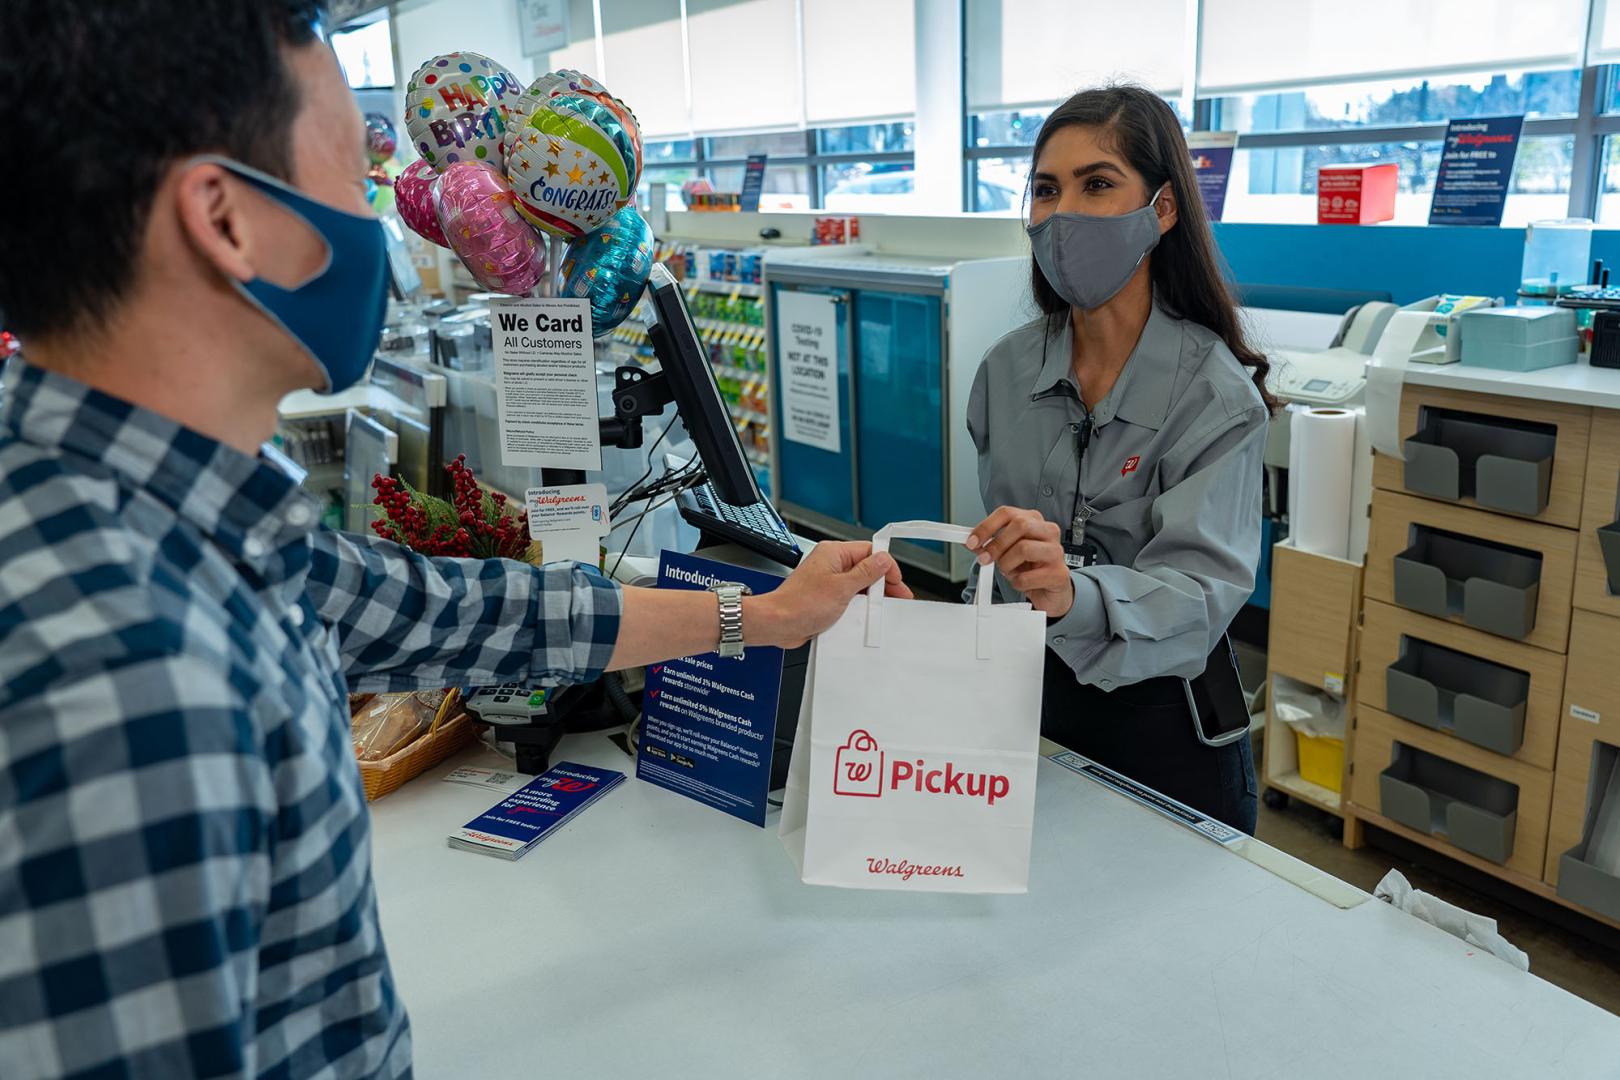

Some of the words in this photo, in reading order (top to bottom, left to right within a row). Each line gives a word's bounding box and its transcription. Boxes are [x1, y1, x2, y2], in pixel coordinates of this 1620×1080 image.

[439, 71, 521, 111] HAPPY
[530, 177, 618, 211] CONGRATS!
[498, 314, 528, 331] We
[536, 314, 583, 332] Card
[504, 337, 517, 347] All
[521, 337, 582, 348] Customers
[666, 564, 728, 587] Introducin
[696, 659, 713, 670] prices
[662, 676, 683, 687] rewards
[663, 666, 675, 675] Earn
[676, 671, 702, 684] unlimited
[711, 681, 740, 696] Walgreens
[740, 690, 754, 700] Cash
[659, 701, 680, 712] rewards
[688, 710, 715, 724] Walgreens
[715, 718, 738, 732] branded
[661, 691, 673, 700] Earn
[673, 696, 699, 709] unlimited
[699, 704, 708, 712] 5%
[709, 707, 737, 722] Walgreens
[738, 717, 751, 727] Cash
[552, 768, 600, 781] Introducing
[891, 759, 1010, 805] Pickup
[508, 799, 556, 811] experience
[515, 794, 560, 806] rewarding
[521, 821, 540, 831] today!
[867, 858, 964, 881] Walgreens
